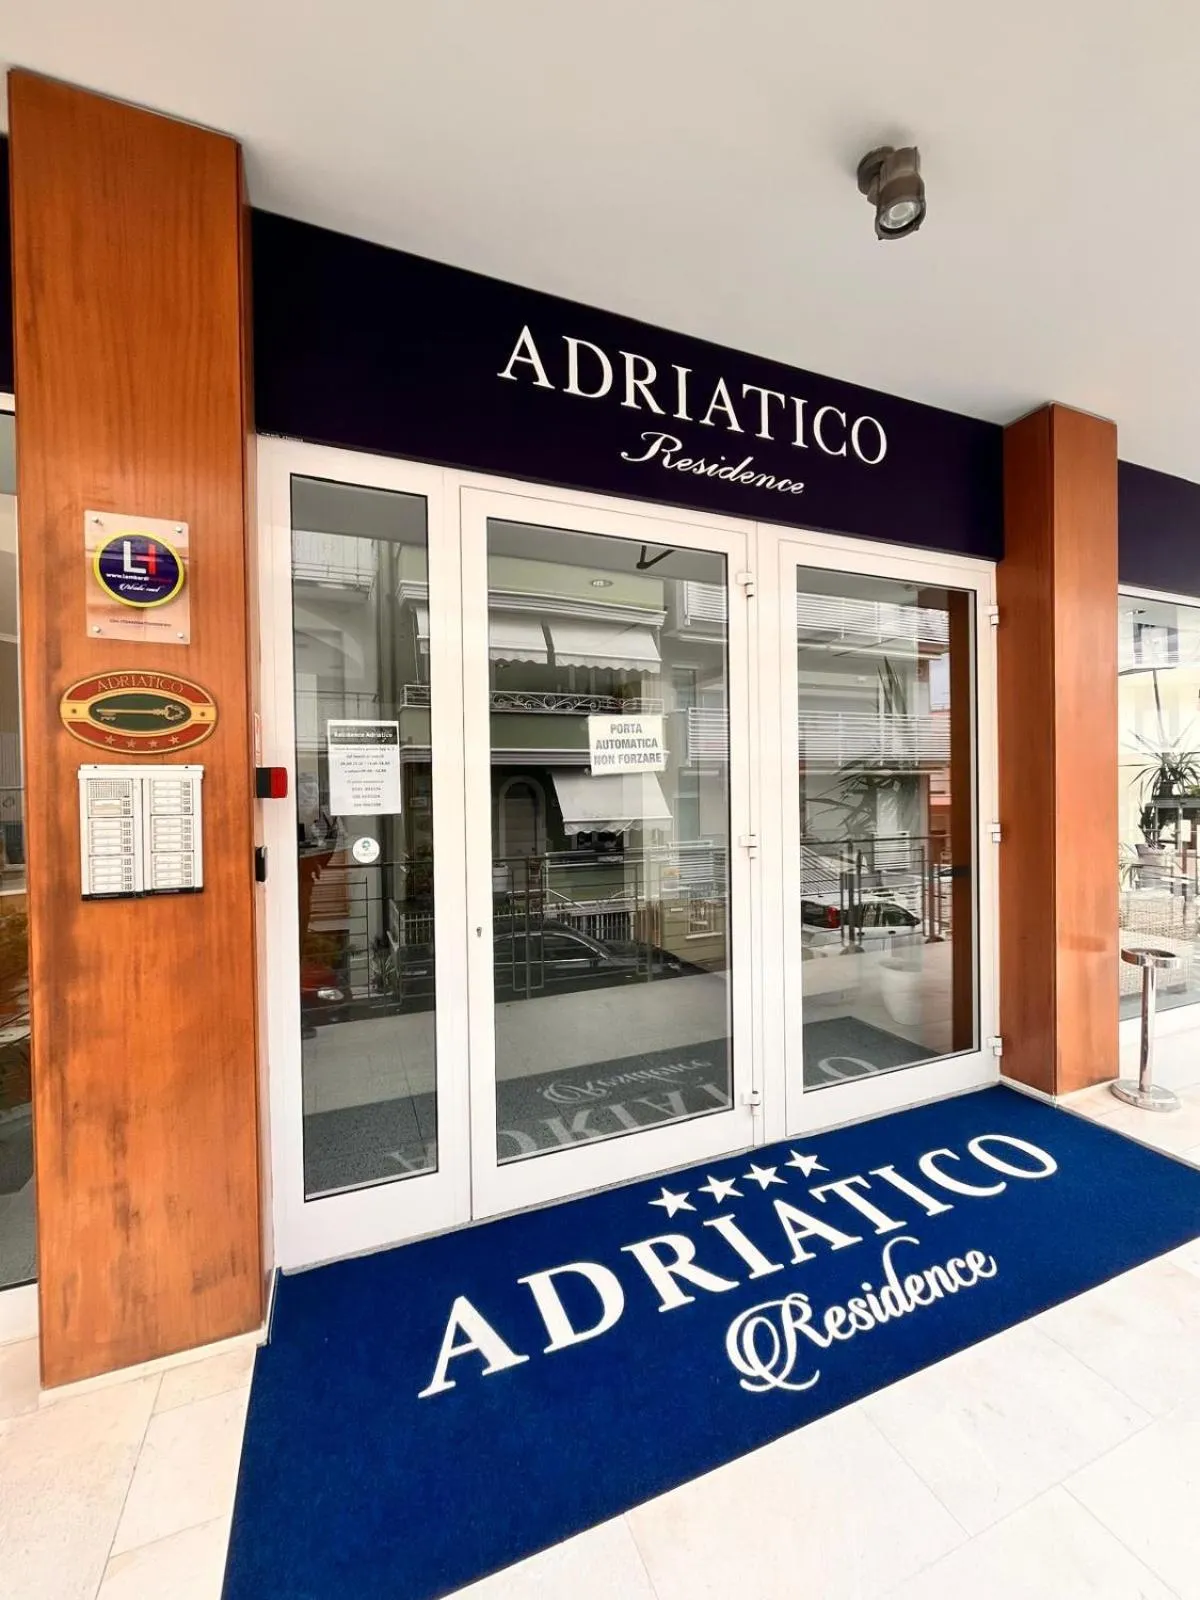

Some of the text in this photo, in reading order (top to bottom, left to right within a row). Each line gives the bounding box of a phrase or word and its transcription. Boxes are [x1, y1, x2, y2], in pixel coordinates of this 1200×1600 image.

[496, 325, 889, 466] ADRIATICO
[620, 431, 806, 495] Residence
[96, 674, 184, 693] ADRIATICO
[596, 738, 658, 750] AUTOMATICA
[610, 723, 643, 735] PORTA
[593, 752, 662, 766] NON FORZARE
[418, 1134, 1059, 1399] ADRIATICO
[725, 1236, 998, 1393] Residence
